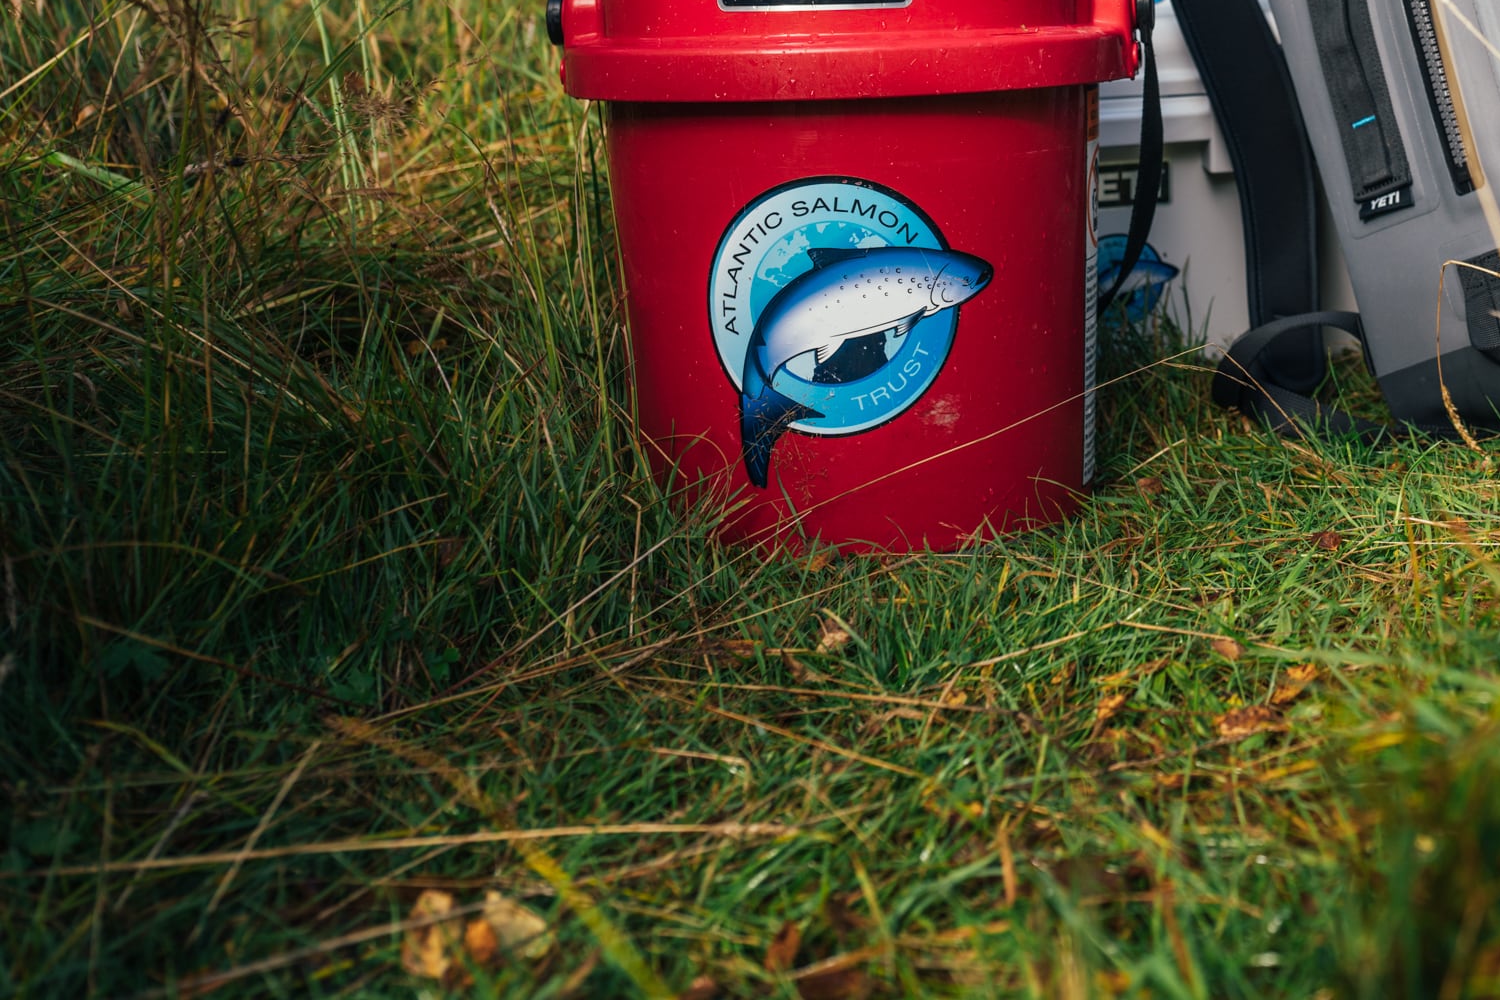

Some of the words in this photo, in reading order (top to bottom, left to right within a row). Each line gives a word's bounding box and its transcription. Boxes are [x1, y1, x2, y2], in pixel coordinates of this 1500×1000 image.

[1098, 169, 1163, 202] ET
[1370, 190, 1400, 210] YETI
[722, 210, 784, 336] ATLANTIC
[790, 196, 919, 245] SALMON
[850, 341, 930, 412] TRUST
